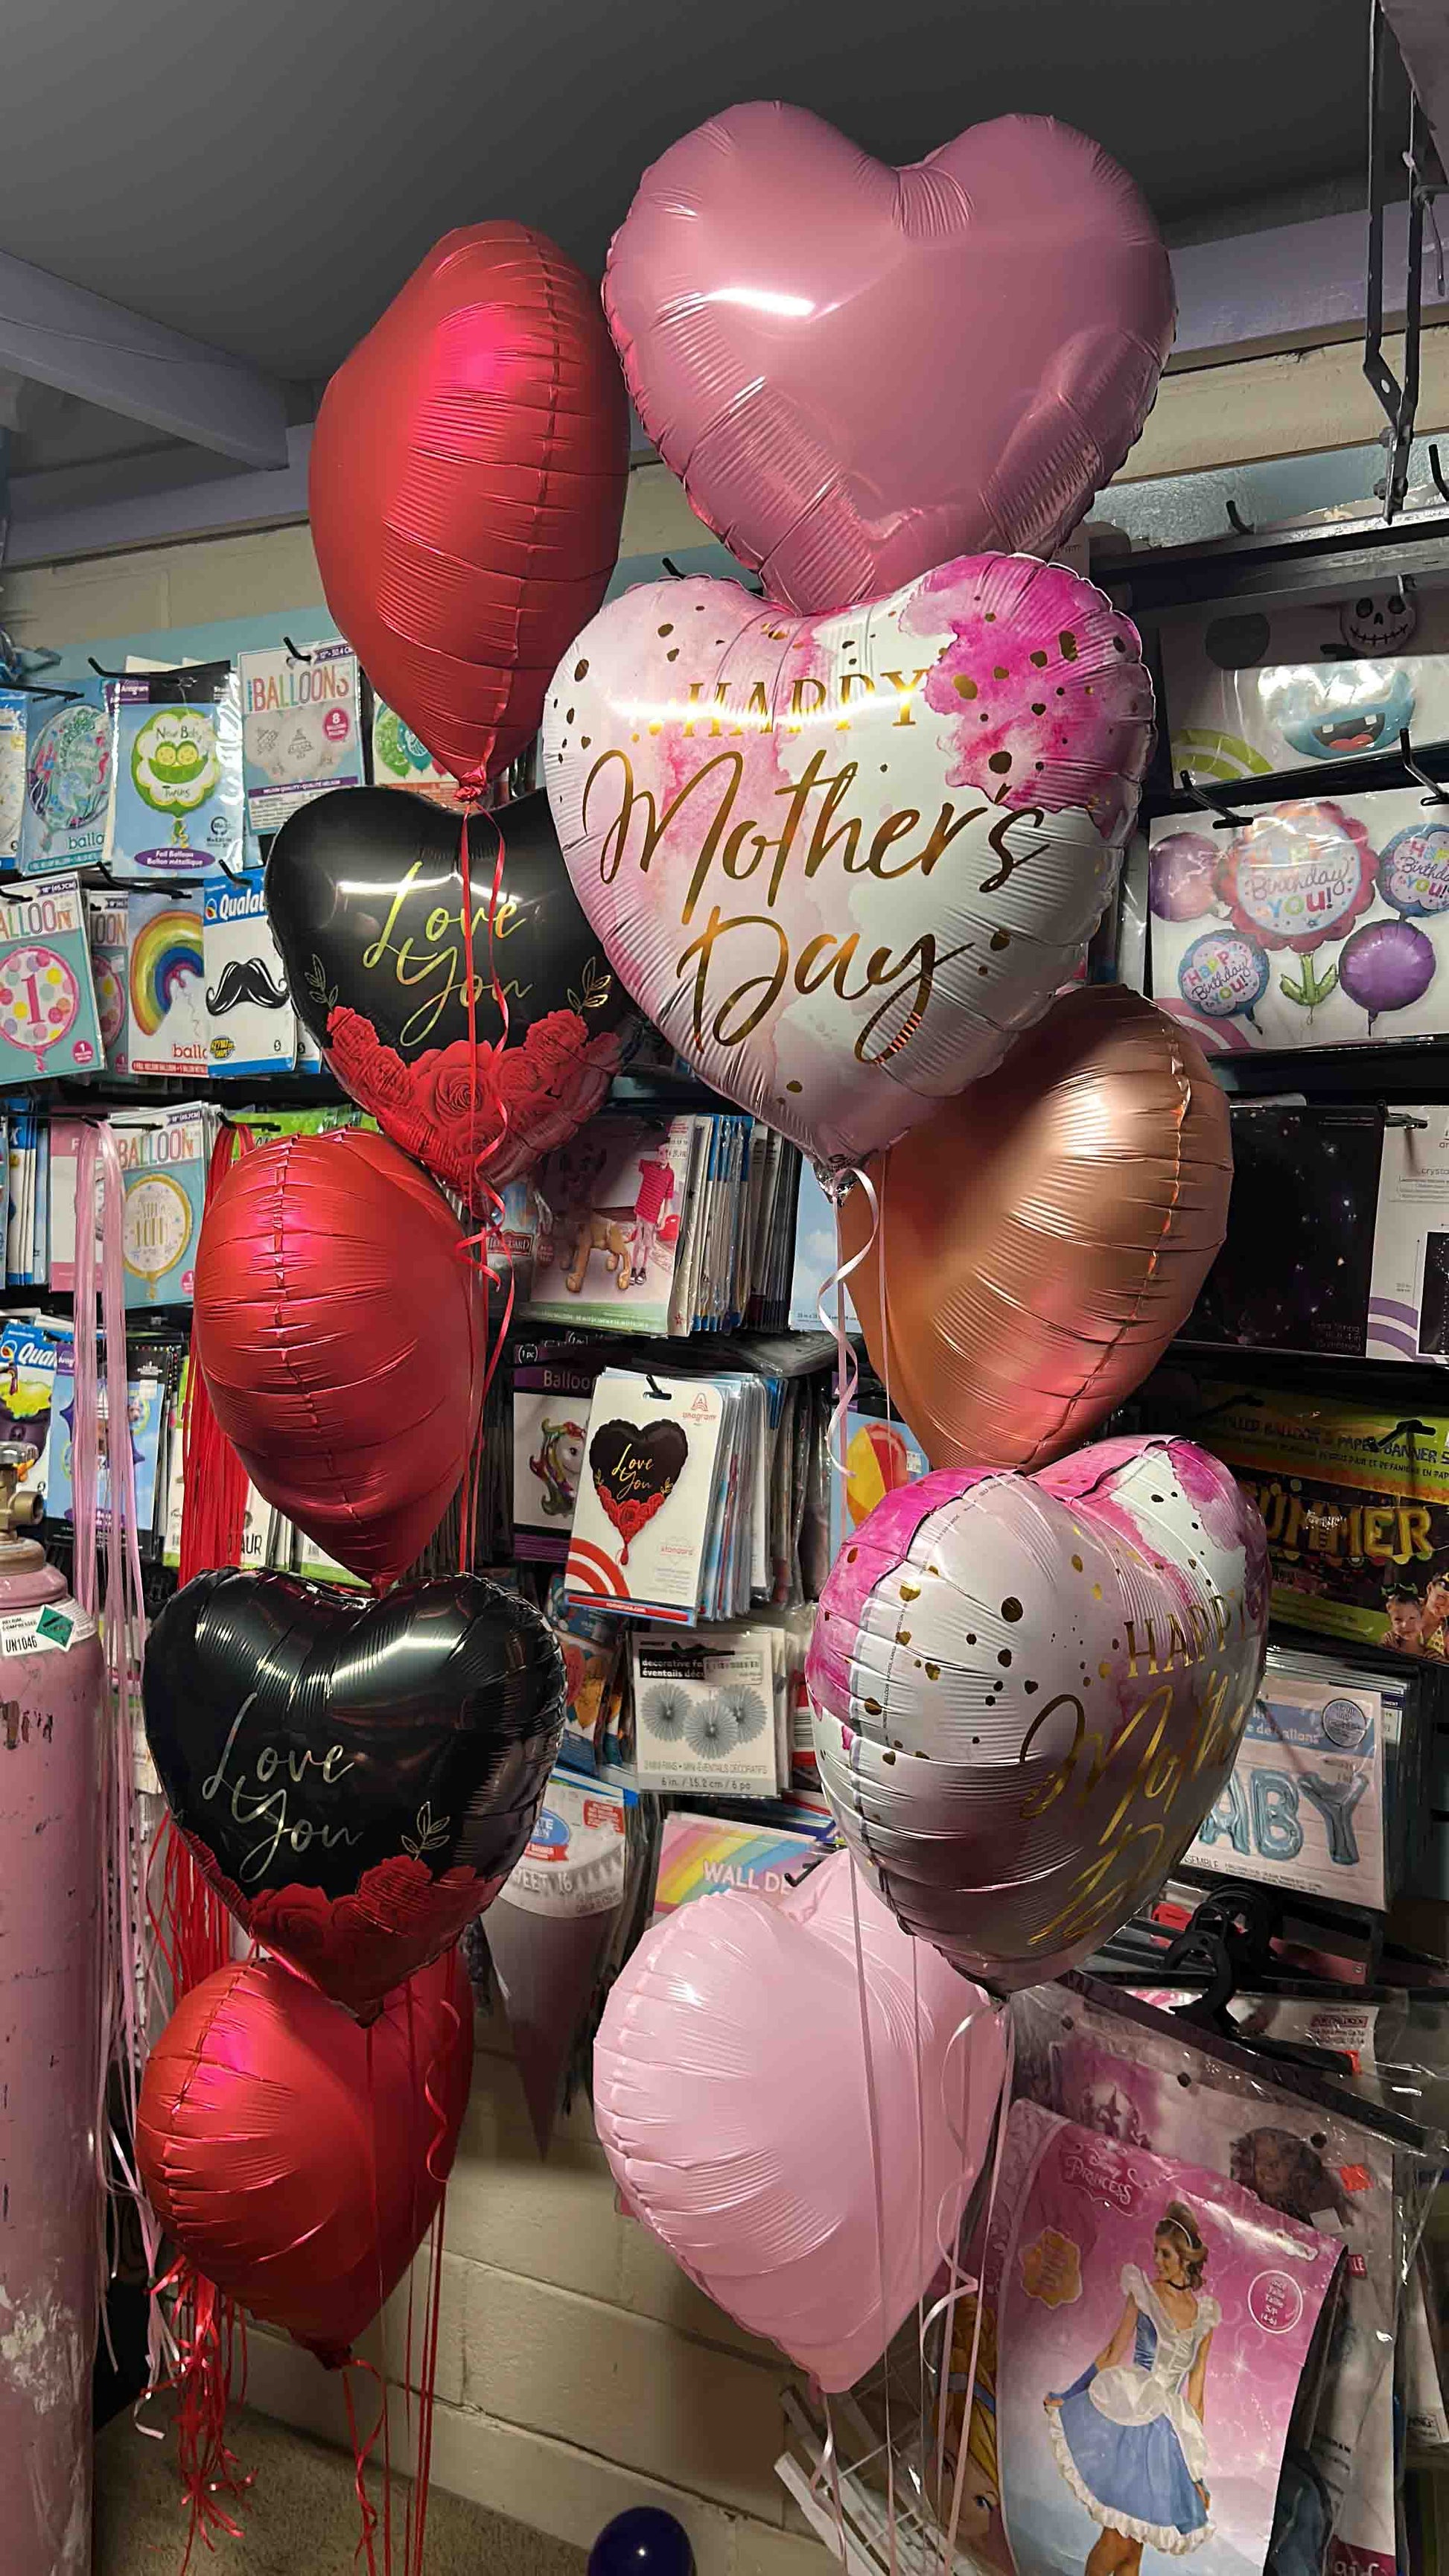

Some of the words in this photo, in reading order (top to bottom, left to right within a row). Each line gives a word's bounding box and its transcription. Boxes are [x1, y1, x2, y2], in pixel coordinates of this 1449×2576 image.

[332, 712, 340, 724] 8
[683, 669, 929, 739] HAPPY
[582, 750, 1051, 925] Mother's
[363, 861, 527, 969] Love
[21, 973, 46, 1025] 1
[395, 937, 533, 1047] You
[676, 906, 976, 1065] Day
[1191, 954, 1252, 1004] Birthday
[611, 1443, 655, 1475] Love
[1383, 1441, 1438, 1464] BANNER
[619, 1467, 652, 1500] You
[5, 1634, 38, 1654] UN1046
[642, 1658, 690, 1668] decorative
[643, 1668, 684, 1677] éventails
[202, 1692, 356, 1800] Love
[708, 1780, 724, 1788] cm
[230, 1775, 364, 1883] You
[702, 1858, 760, 1890] WALL
[1066, 2155, 1133, 2205] PRINCESS
